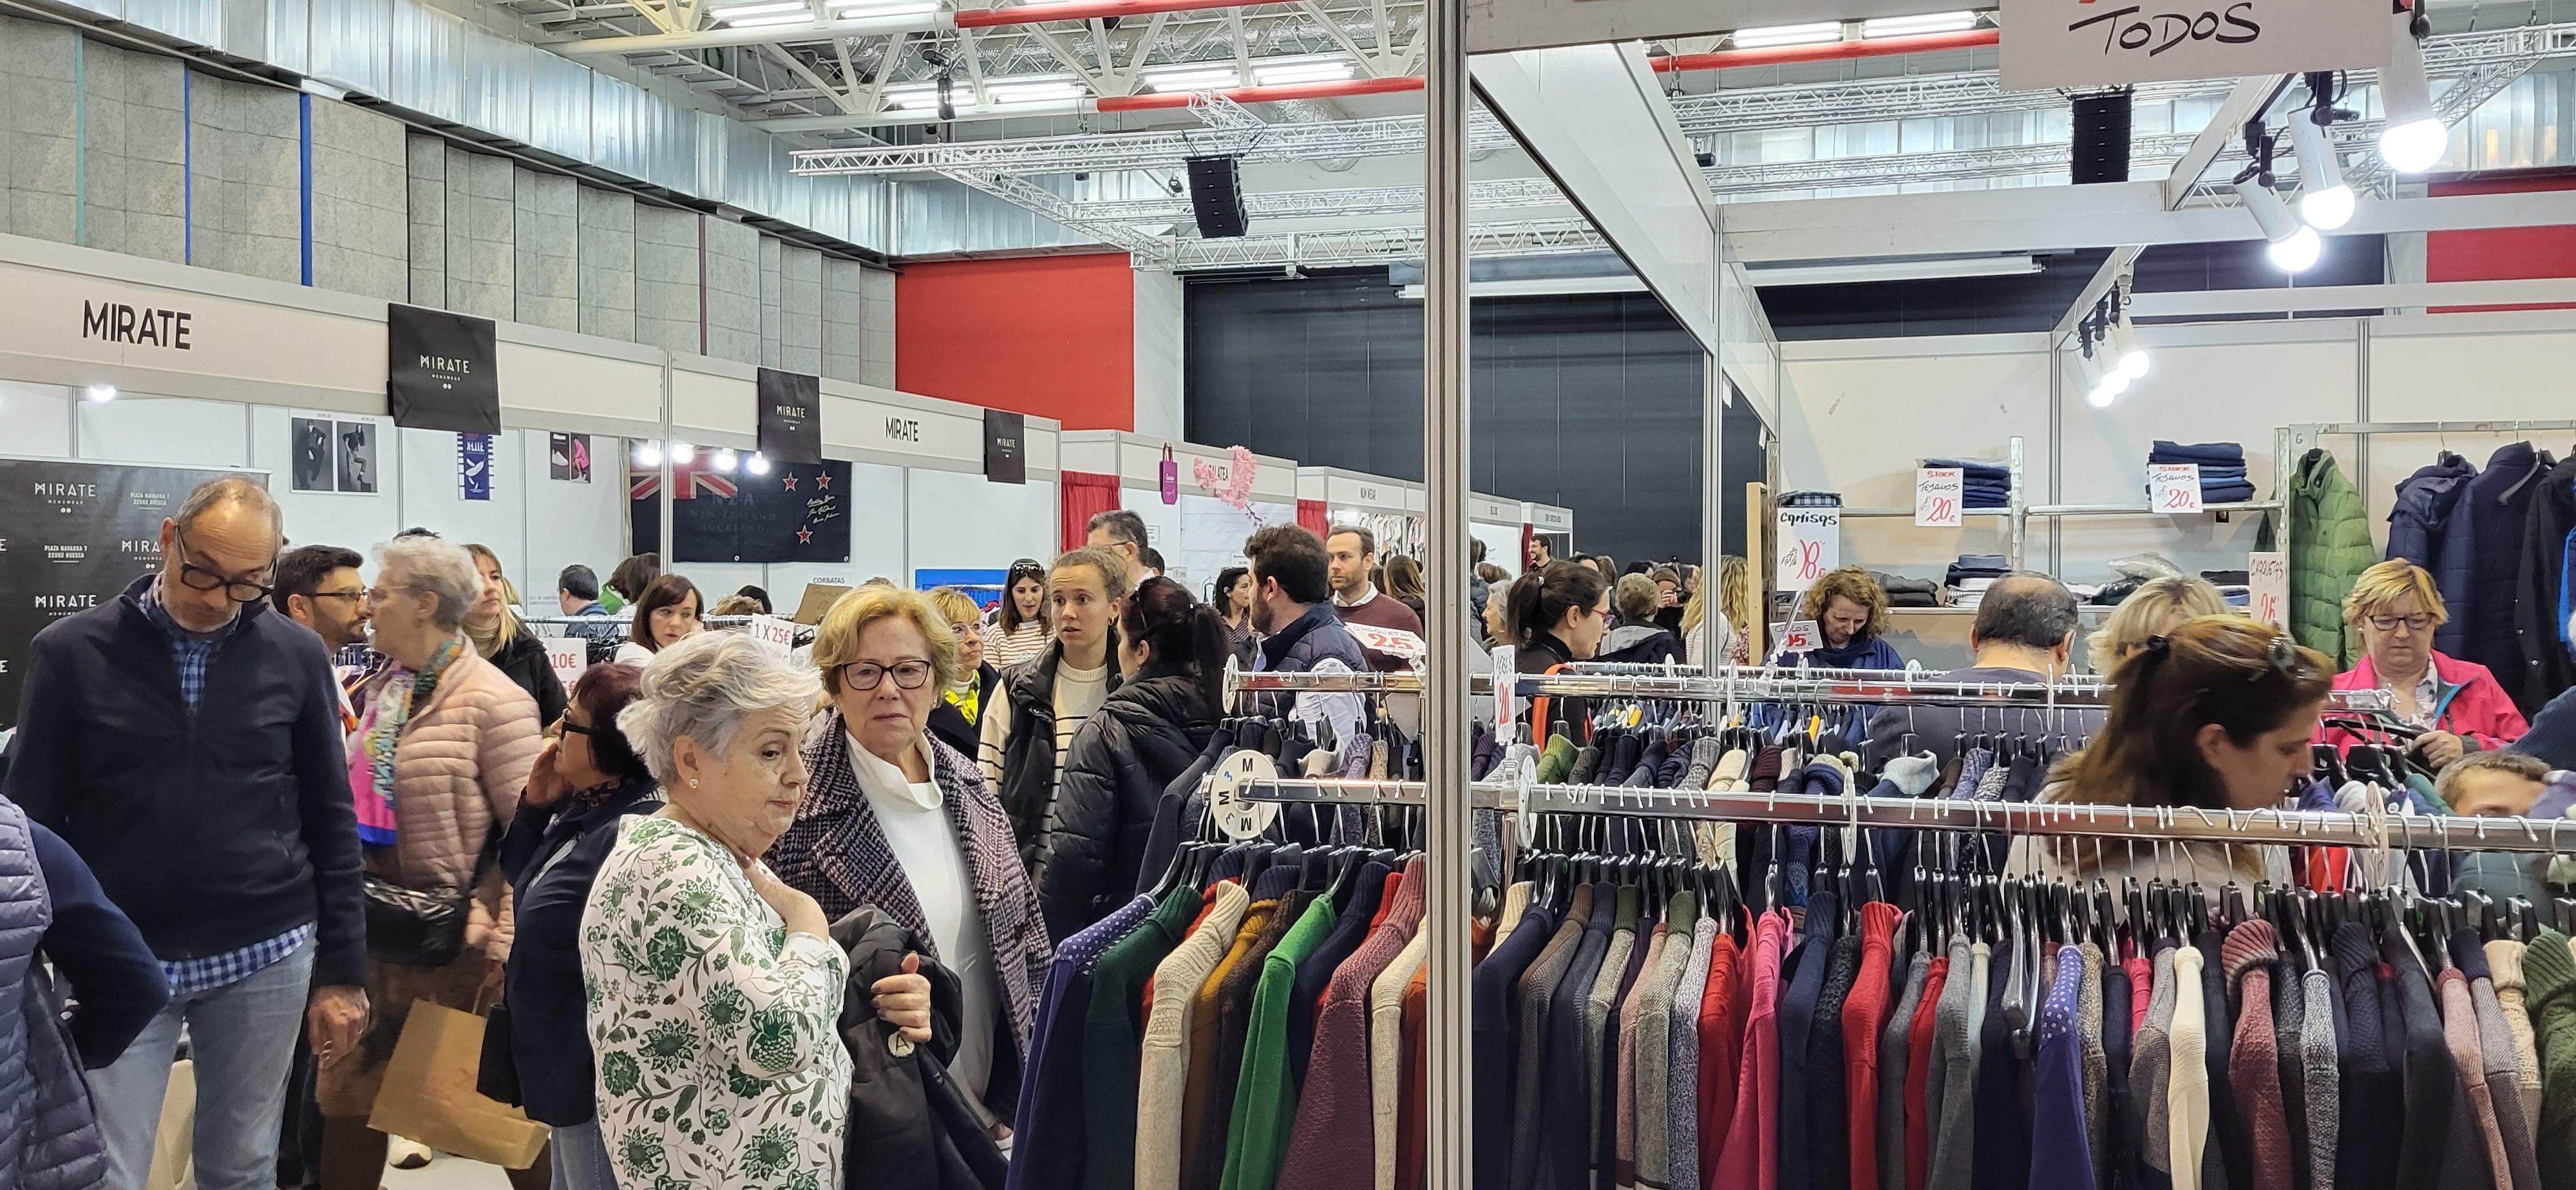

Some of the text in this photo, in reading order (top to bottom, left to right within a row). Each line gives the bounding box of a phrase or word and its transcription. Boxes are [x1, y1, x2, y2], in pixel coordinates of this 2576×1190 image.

[2069, 3, 2260, 57] TODOS
[83, 299, 191, 350] MIRATE
[421, 354, 470, 373] MIRATE
[777, 405, 805, 419] MIRATE
[886, 417, 919, 442] MIRATE
[997, 438, 1016, 448] MIRATE
[2152, 473, 2194, 483] TEJANOS
[35, 482, 96, 497] MIRATE
[1918, 480, 1958, 493] TEJANOS
[121, 540, 160, 552] MIRA
[35, 595, 97, 608] MIRATE
[755, 623, 760, 639] 1
[773, 627, 791, 645] 25€
[551, 653, 576, 668] 10€
[1242, 758, 1253, 772] M
[1218, 791, 1230, 806] M
[1240, 817, 1252, 831] M
[895, 1033, 910, 1052] A
